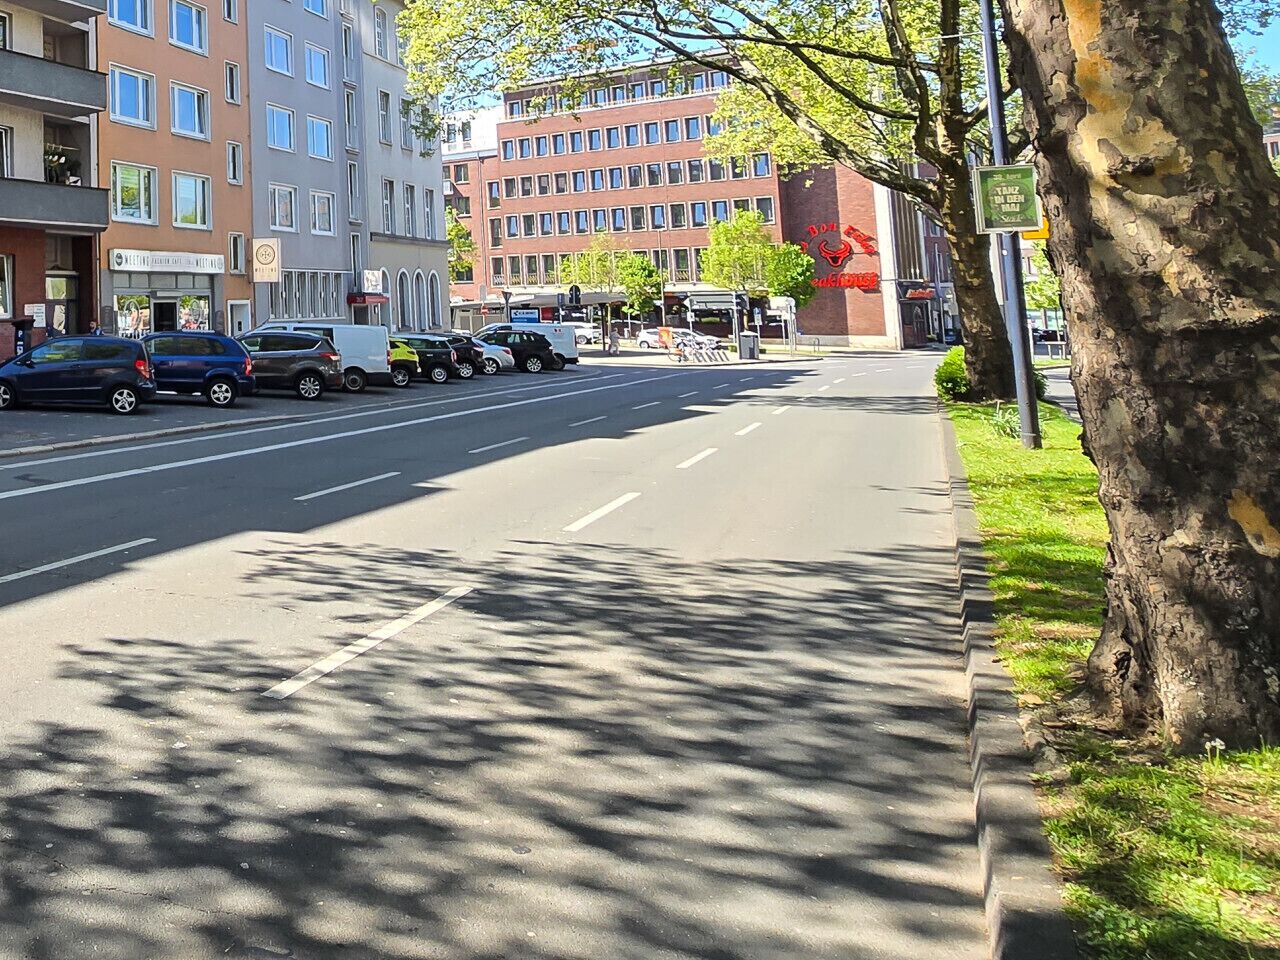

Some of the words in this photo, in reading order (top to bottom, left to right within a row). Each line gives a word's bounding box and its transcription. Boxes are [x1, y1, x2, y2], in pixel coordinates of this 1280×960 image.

[996, 186, 1020, 195] TANZ
[994, 195, 1005, 204] IN
[1007, 195, 1025, 203] DEN
[1001, 203, 1020, 212] MAI
[124, 254, 150, 267] MEETING
[195, 257, 217, 269] MEETING
